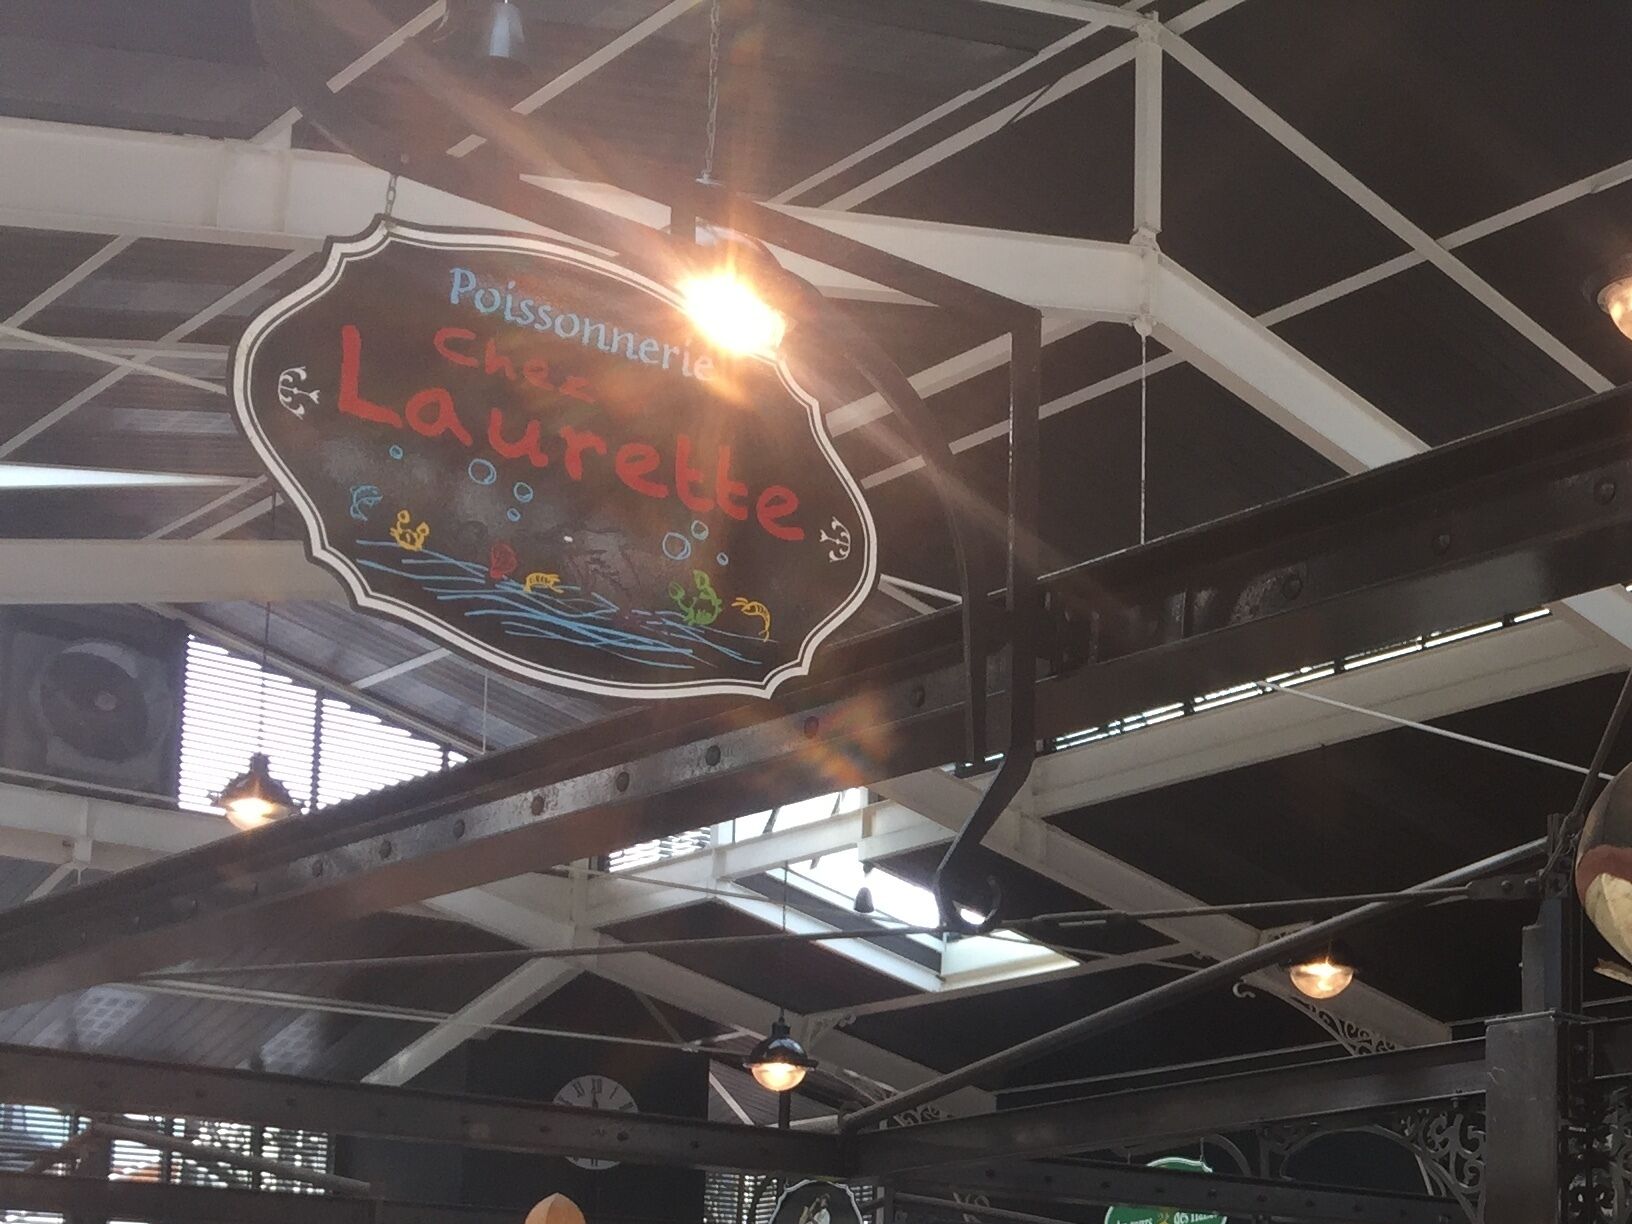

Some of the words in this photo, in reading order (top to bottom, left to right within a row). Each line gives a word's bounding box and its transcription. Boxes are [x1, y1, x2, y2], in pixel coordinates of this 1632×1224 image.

[433, 327, 597, 402] Chez
[449, 266, 716, 381] Poissonnerie
[339, 325, 805, 540] Laurette
